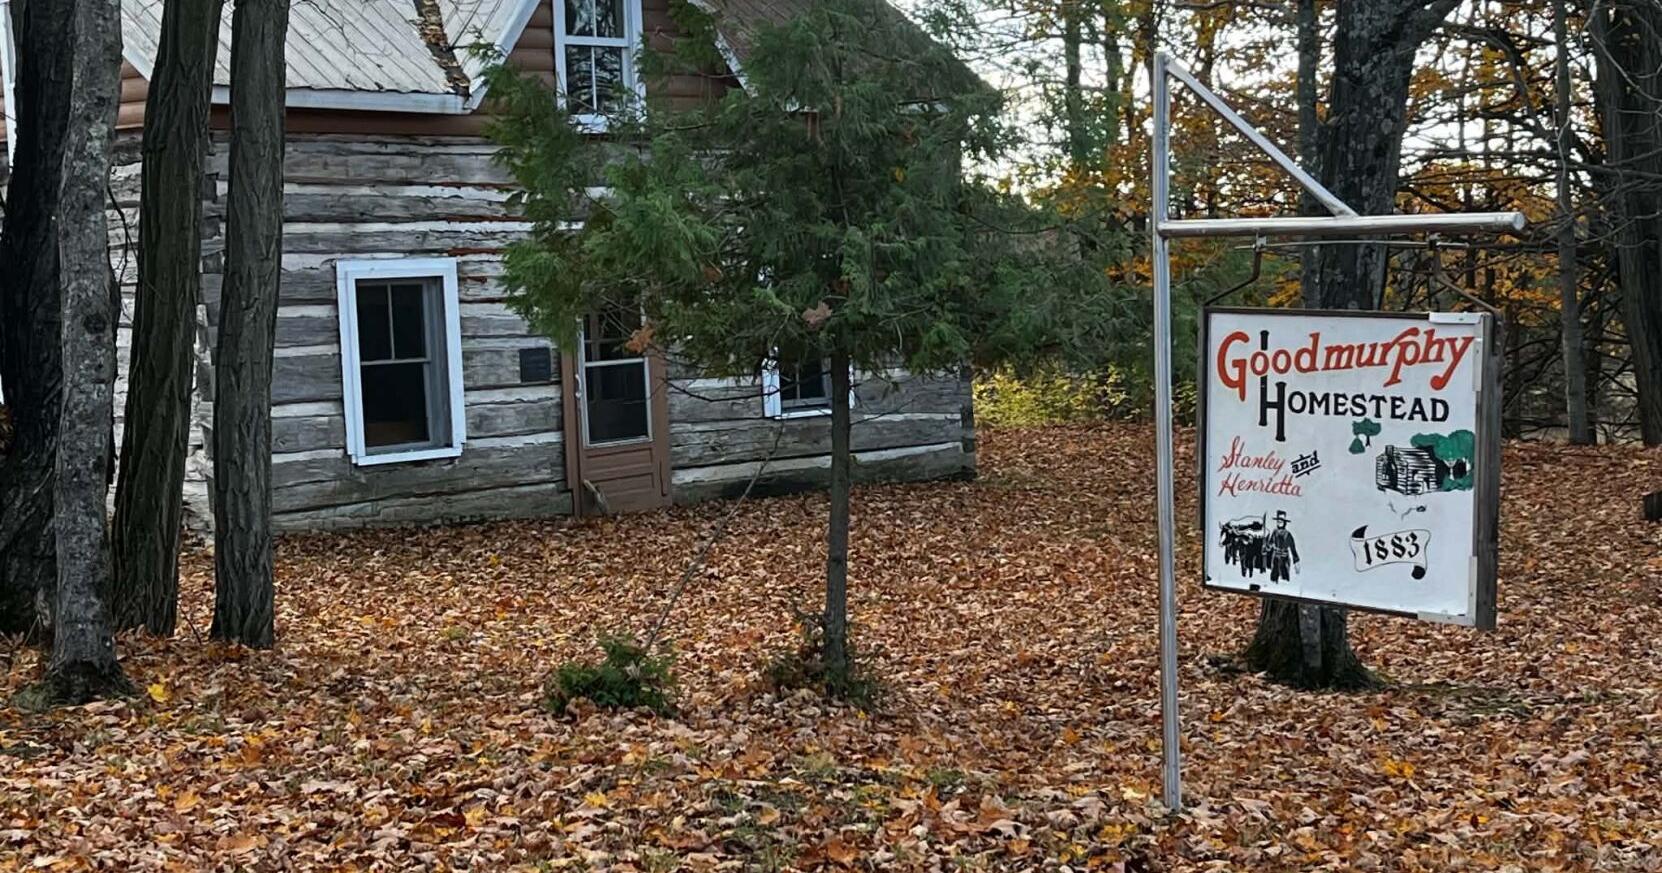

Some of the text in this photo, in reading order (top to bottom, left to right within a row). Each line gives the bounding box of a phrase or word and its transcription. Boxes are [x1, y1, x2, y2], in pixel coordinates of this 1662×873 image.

[1217, 327, 1475, 402] Goodmurphy
[1218, 436, 1320, 475] Stanley and
[1218, 472, 1303, 497] Henrietta
[1364, 532, 1419, 565] 1883
